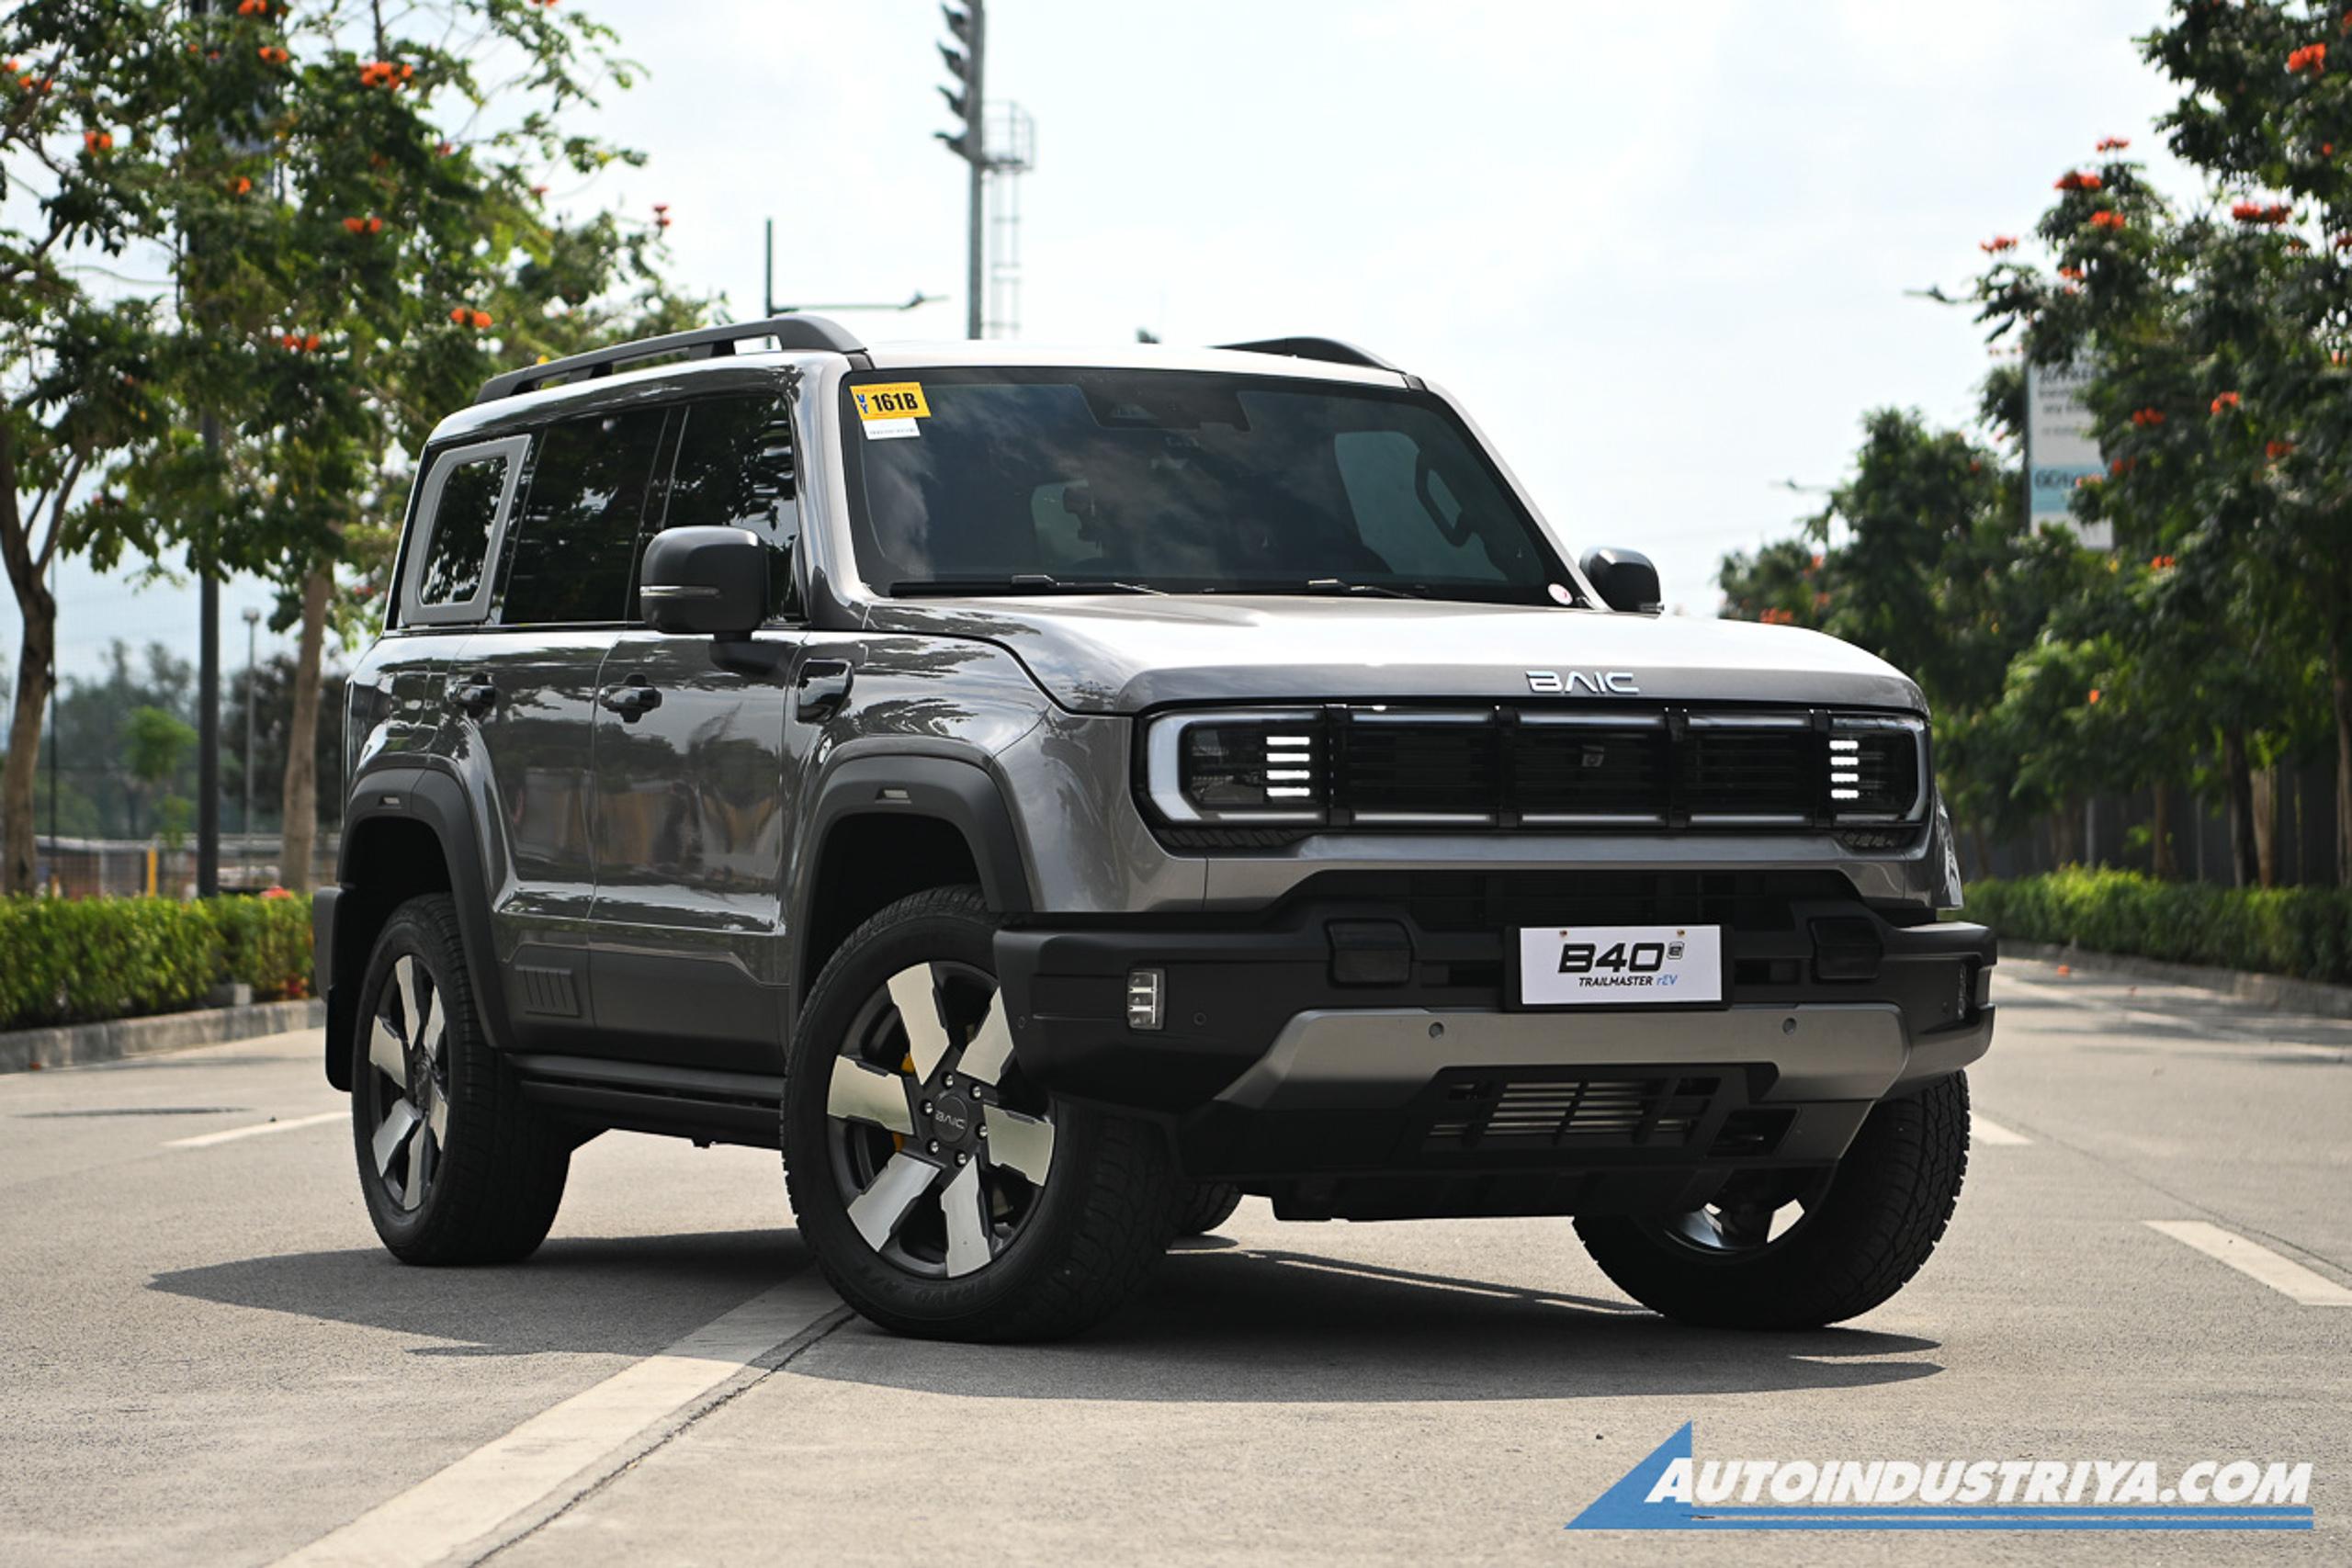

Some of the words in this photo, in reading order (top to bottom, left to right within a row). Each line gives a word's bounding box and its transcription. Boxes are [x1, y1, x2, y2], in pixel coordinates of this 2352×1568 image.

[871, 393, 918, 412] 161B
[1526, 671, 1639, 694] BAIC
[1579, 976, 1654, 987] TRAILMASTER
[935, 1110, 966, 1131] BAIC
